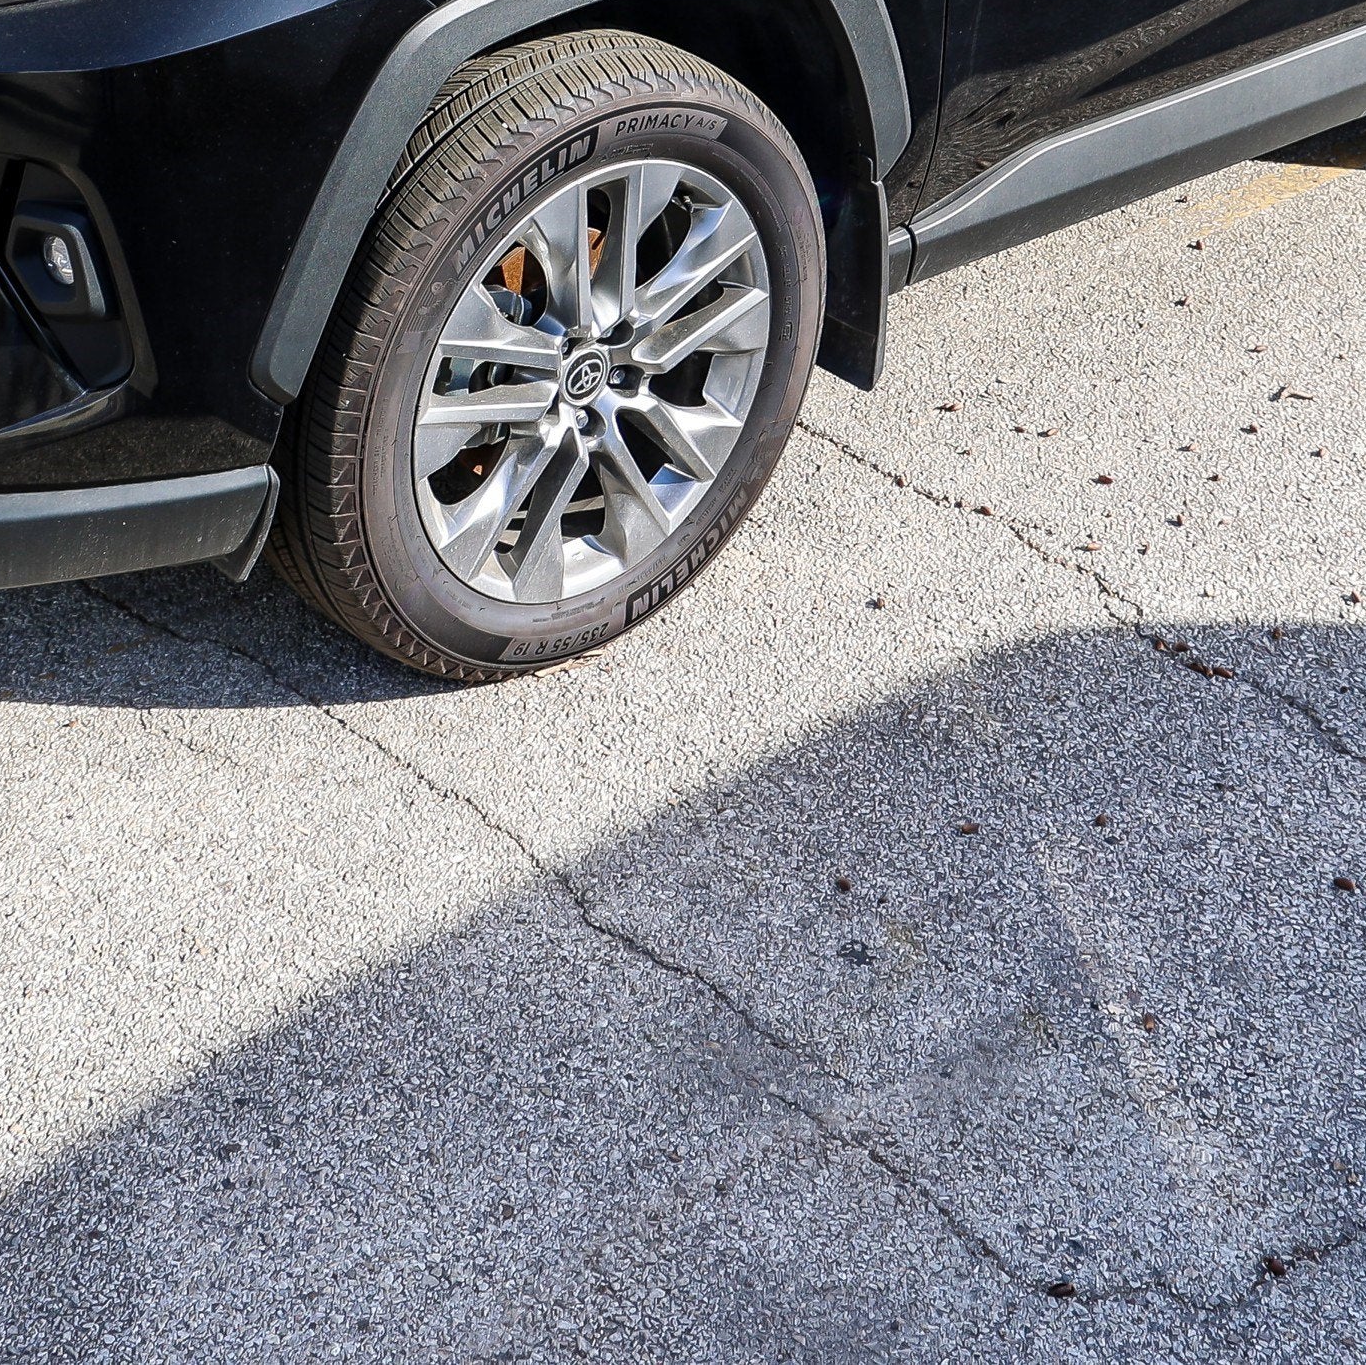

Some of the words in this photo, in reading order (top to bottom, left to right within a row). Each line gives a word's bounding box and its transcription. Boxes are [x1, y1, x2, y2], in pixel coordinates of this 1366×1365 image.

[615, 113, 695, 137] PRIMACY
[453, 134, 592, 277] MICHELIN
[631, 489, 748, 622] MICHELIN
[513, 642, 531, 656] 19
[535, 641, 549, 655] R
